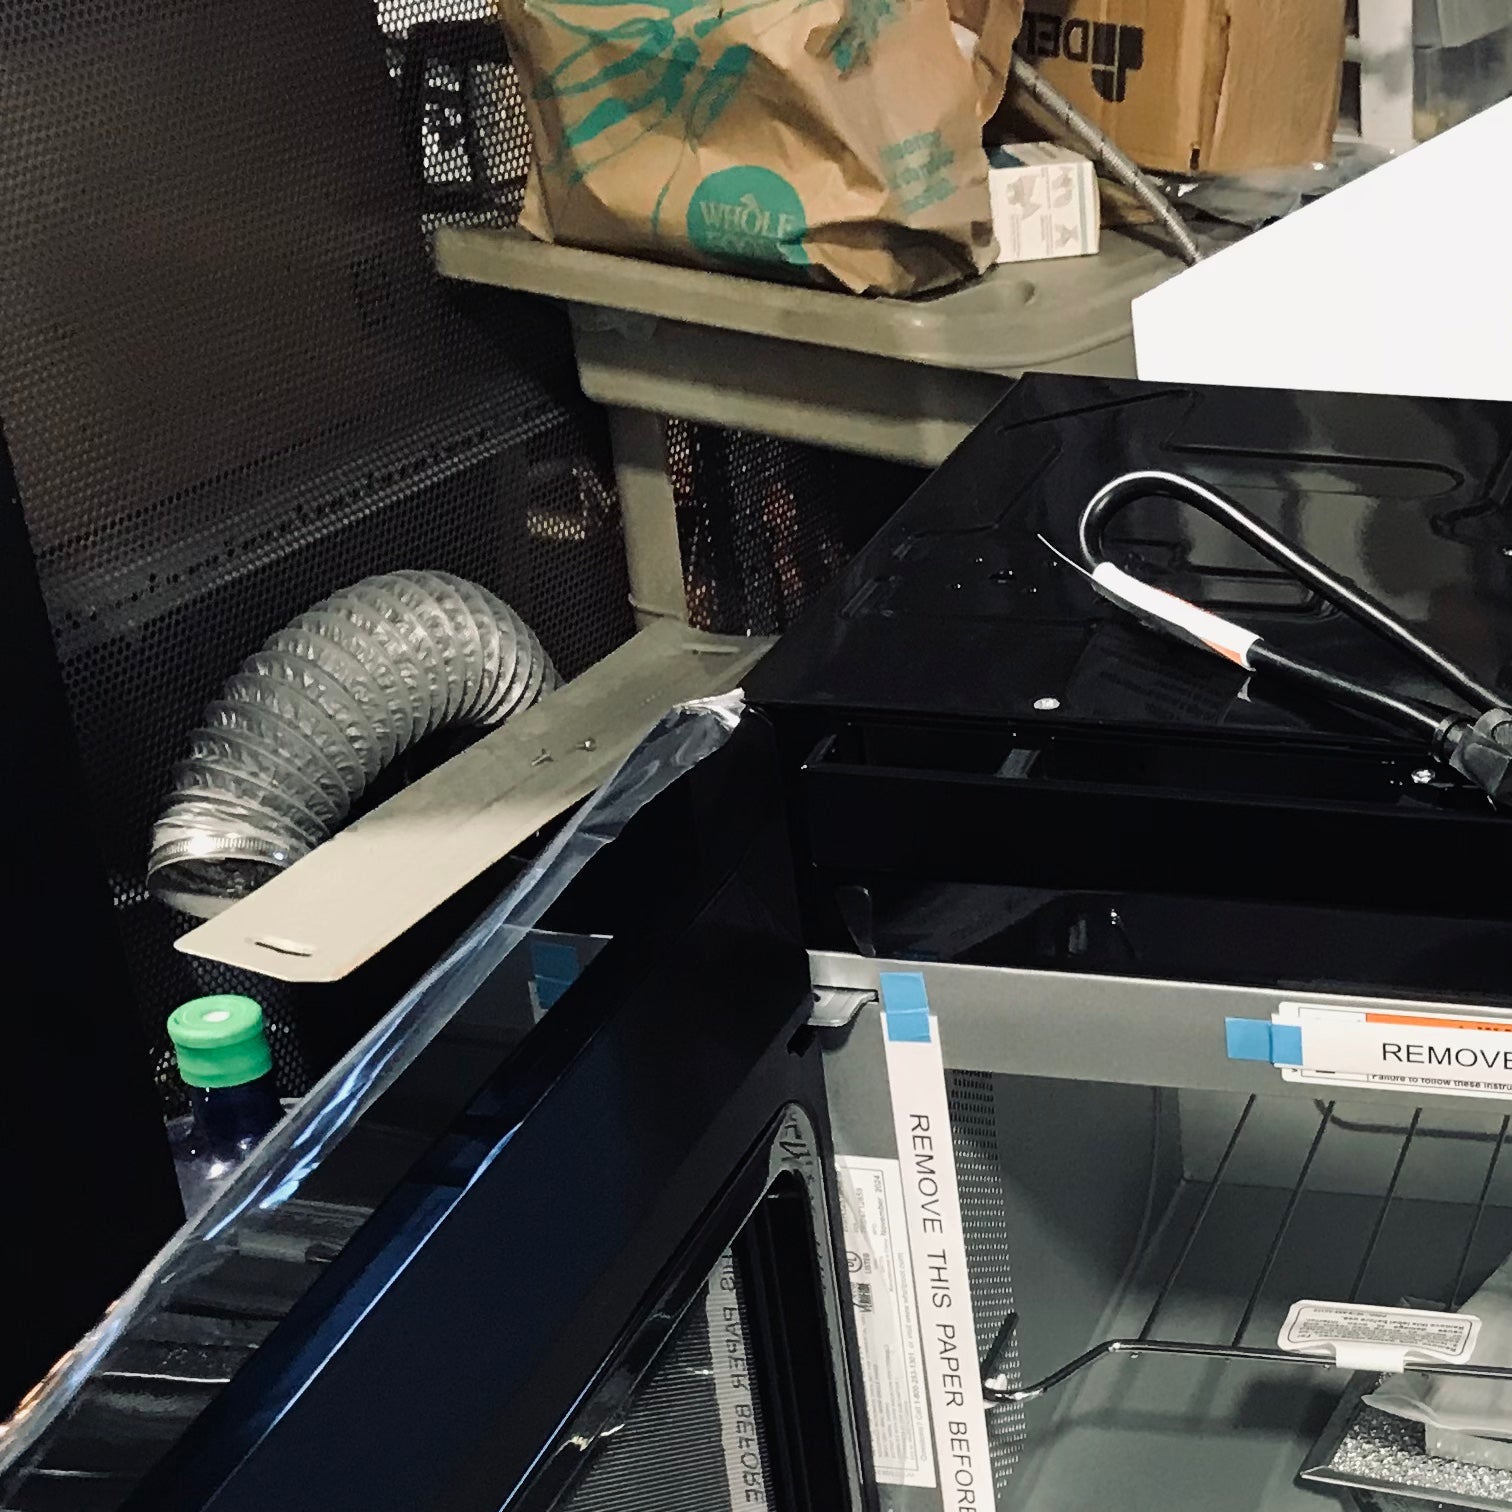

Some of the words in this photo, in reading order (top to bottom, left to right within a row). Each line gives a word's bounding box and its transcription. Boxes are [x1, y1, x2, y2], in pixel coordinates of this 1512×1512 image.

[1453, 1078, 1481, 1089] these
[909, 1114, 943, 1234] REMOVE
[927, 1249, 952, 1309] THIS
[936, 1322, 964, 1407] PAPER
